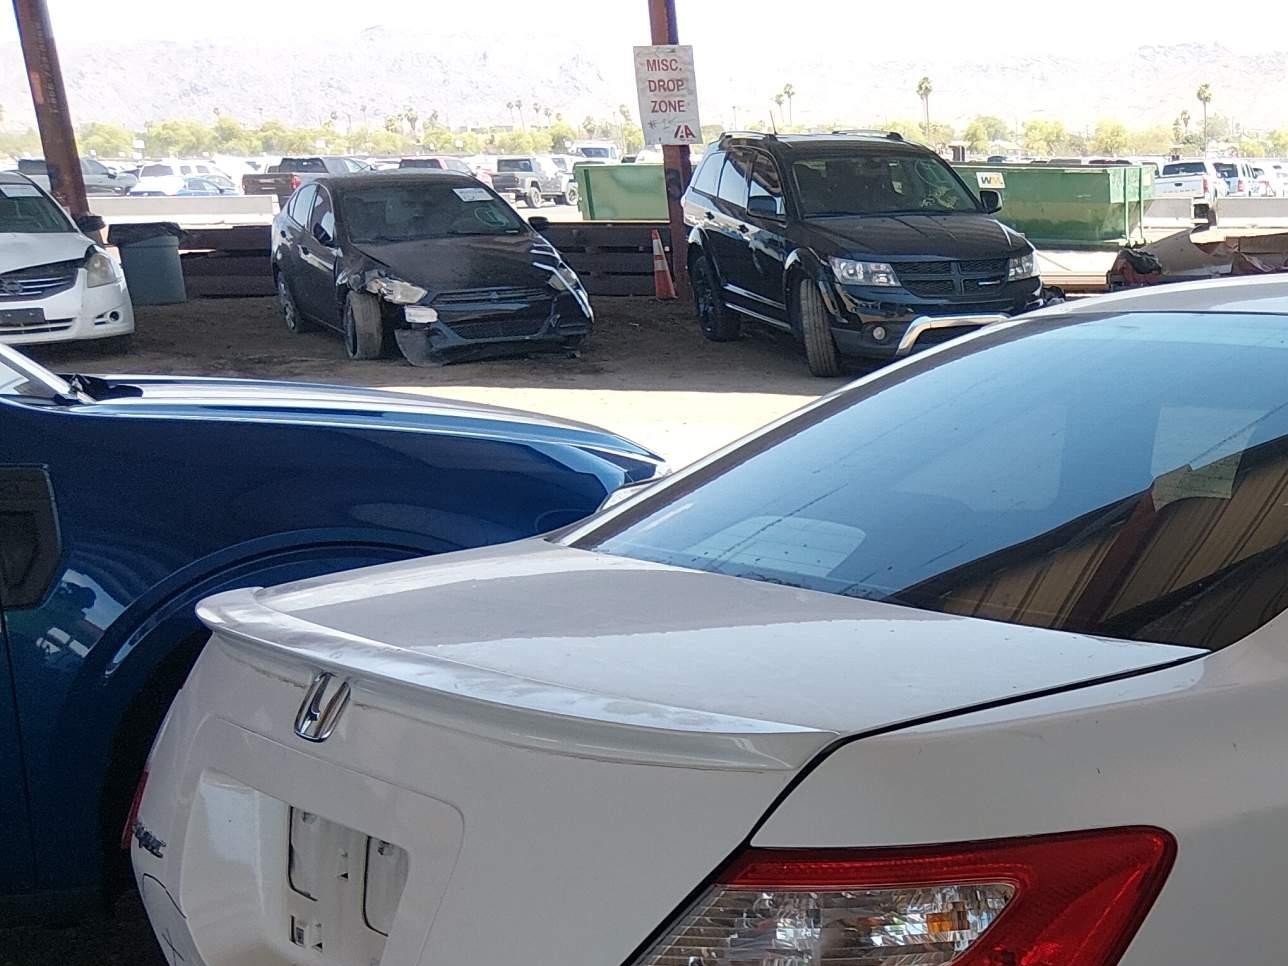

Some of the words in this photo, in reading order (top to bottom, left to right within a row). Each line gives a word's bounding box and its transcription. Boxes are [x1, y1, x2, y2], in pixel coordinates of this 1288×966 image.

[646, 58, 682, 72] MISC.
[648, 79, 685, 92] DROP
[650, 100, 686, 113] ZONE
